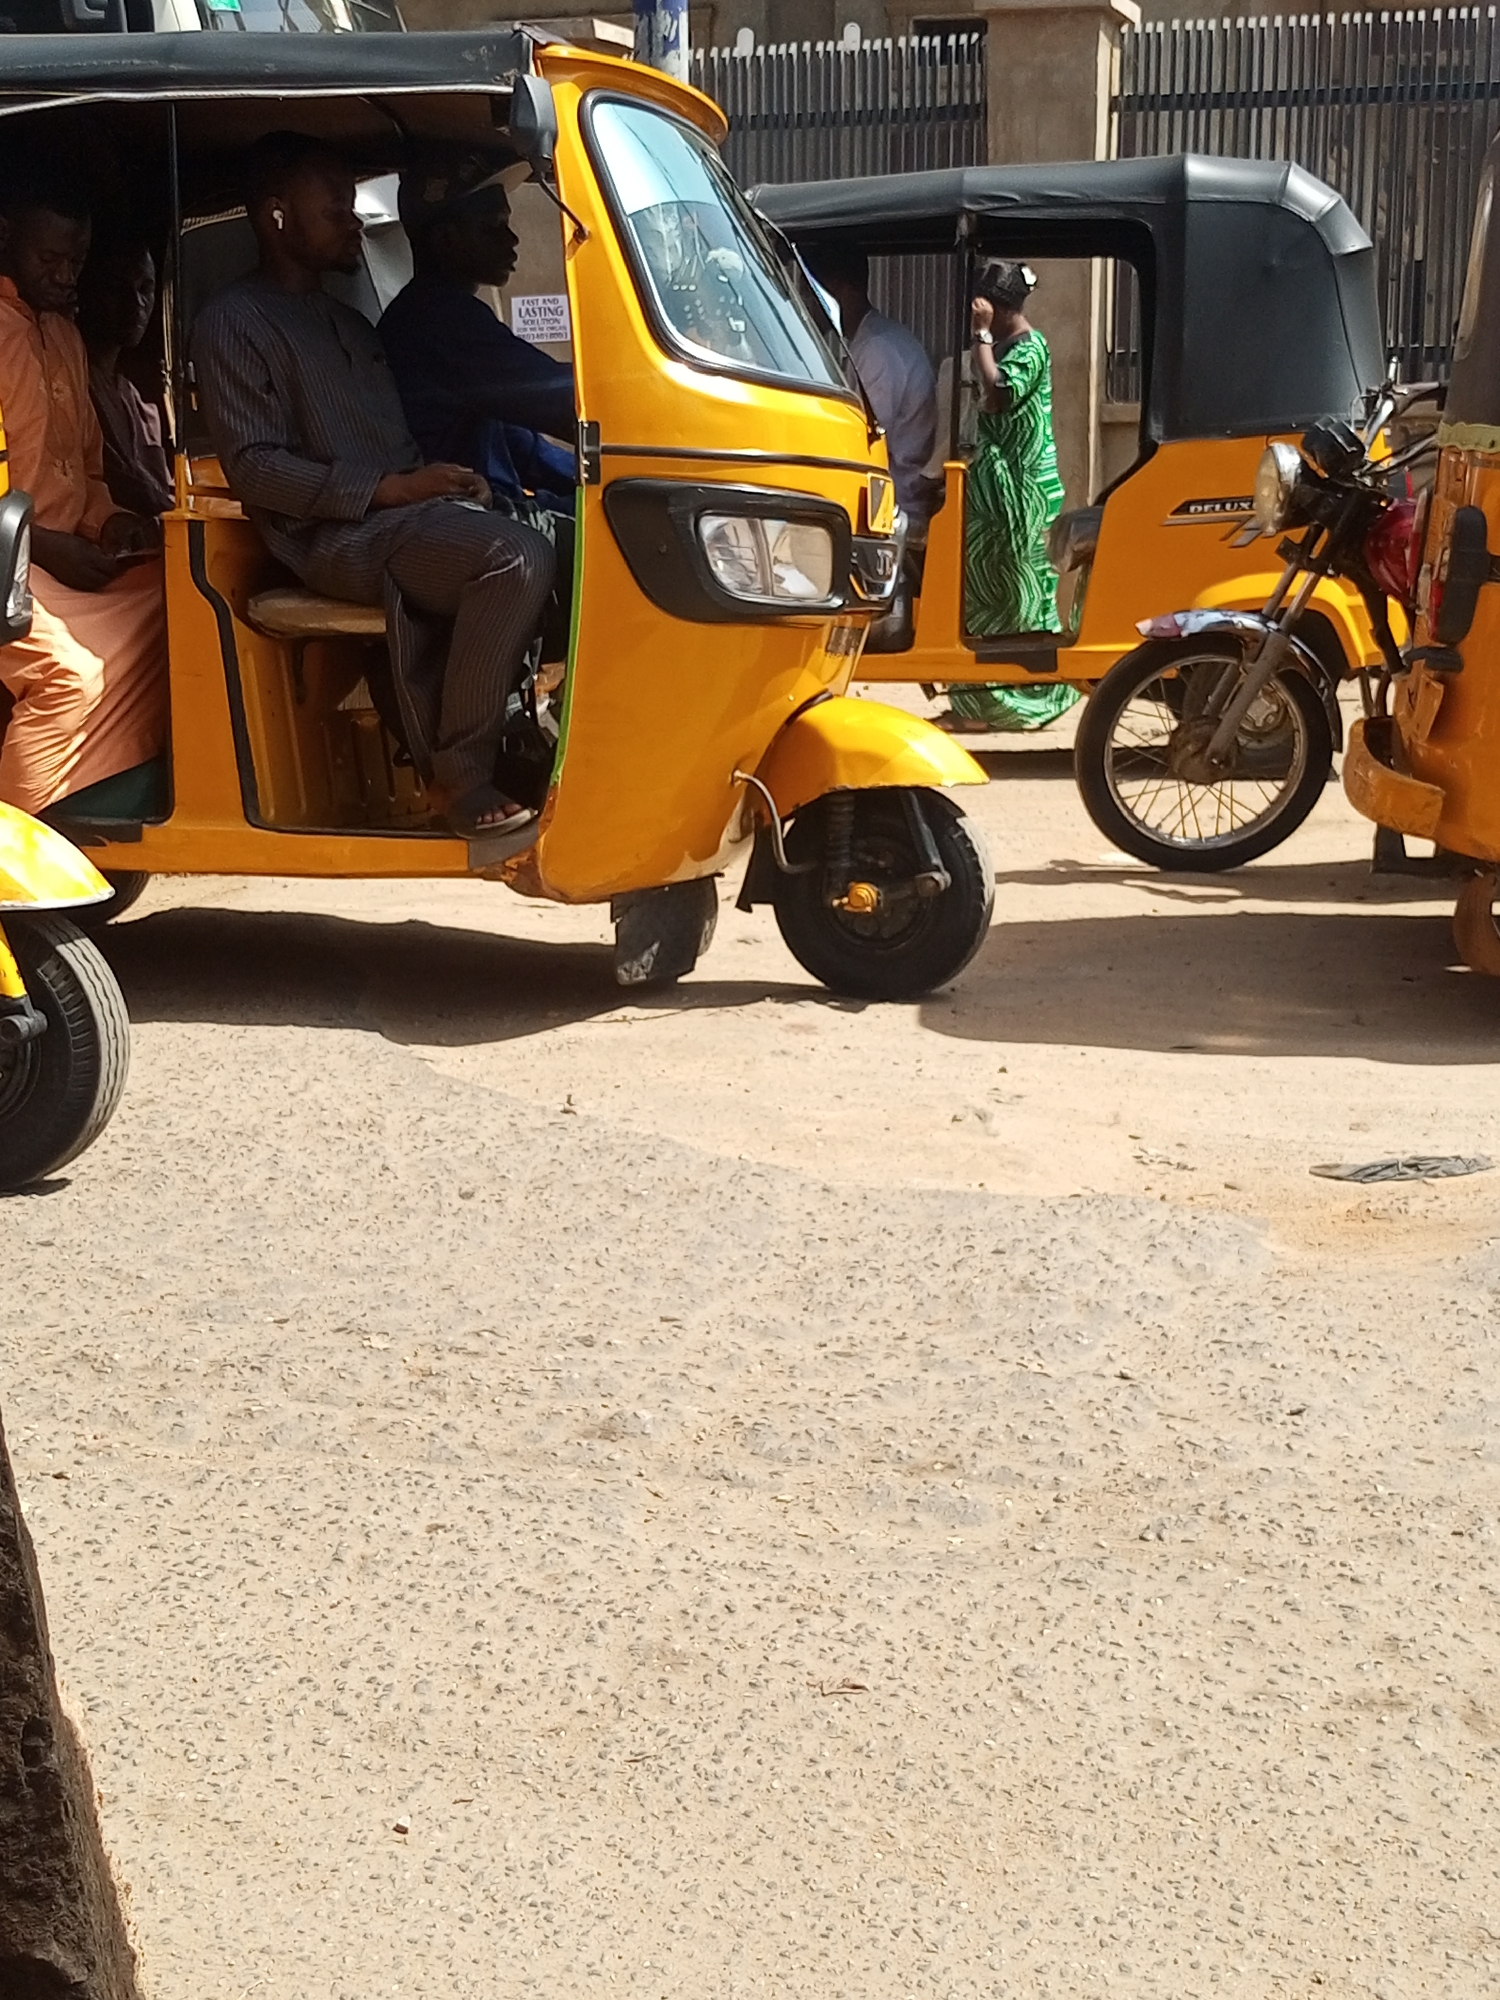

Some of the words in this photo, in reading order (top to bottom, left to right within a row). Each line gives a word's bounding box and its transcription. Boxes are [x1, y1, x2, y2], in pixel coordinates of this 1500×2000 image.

[518, 306, 564, 318] LASTING
[522, 318, 561, 326] SOLUTION
[1189, 501, 1256, 514] DELUX
